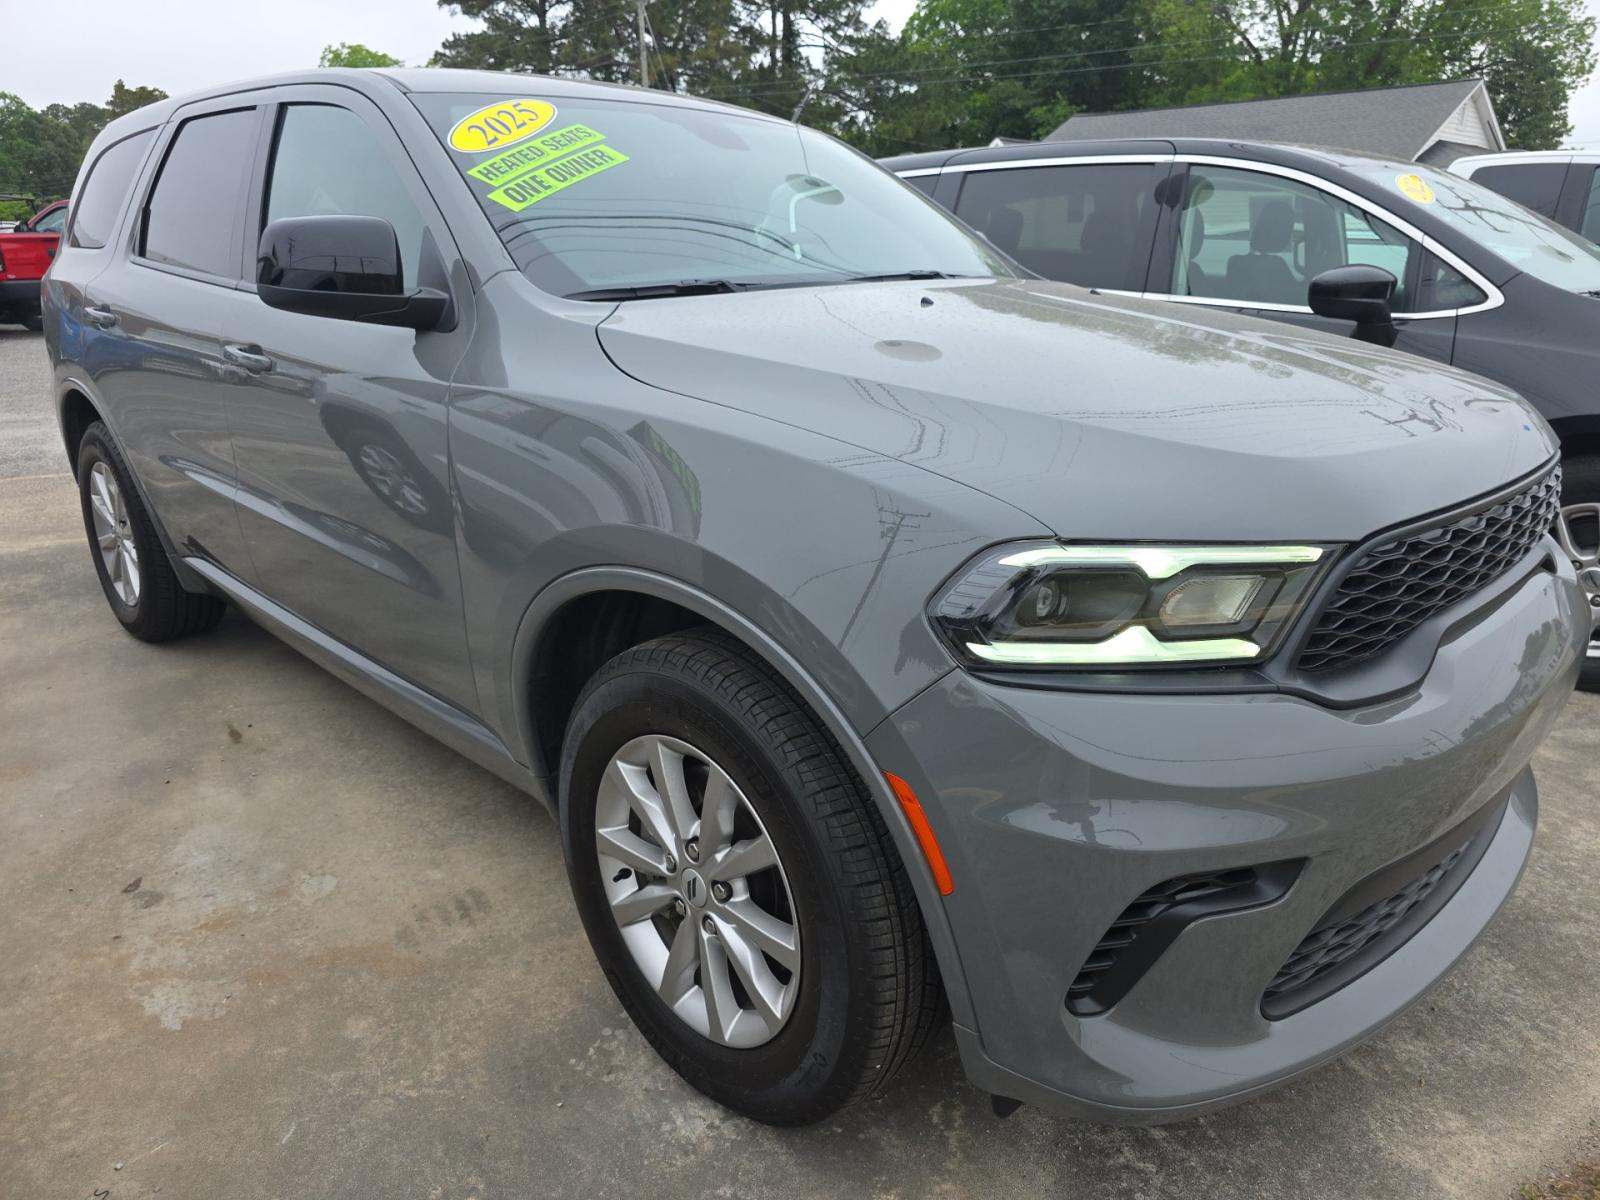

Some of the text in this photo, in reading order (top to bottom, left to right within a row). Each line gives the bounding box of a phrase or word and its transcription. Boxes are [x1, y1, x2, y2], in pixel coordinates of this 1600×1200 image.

[467, 103, 539, 146] 2025
[477, 127, 592, 181] HEATED SEATS
[503, 149, 615, 203] ONE OWNER
